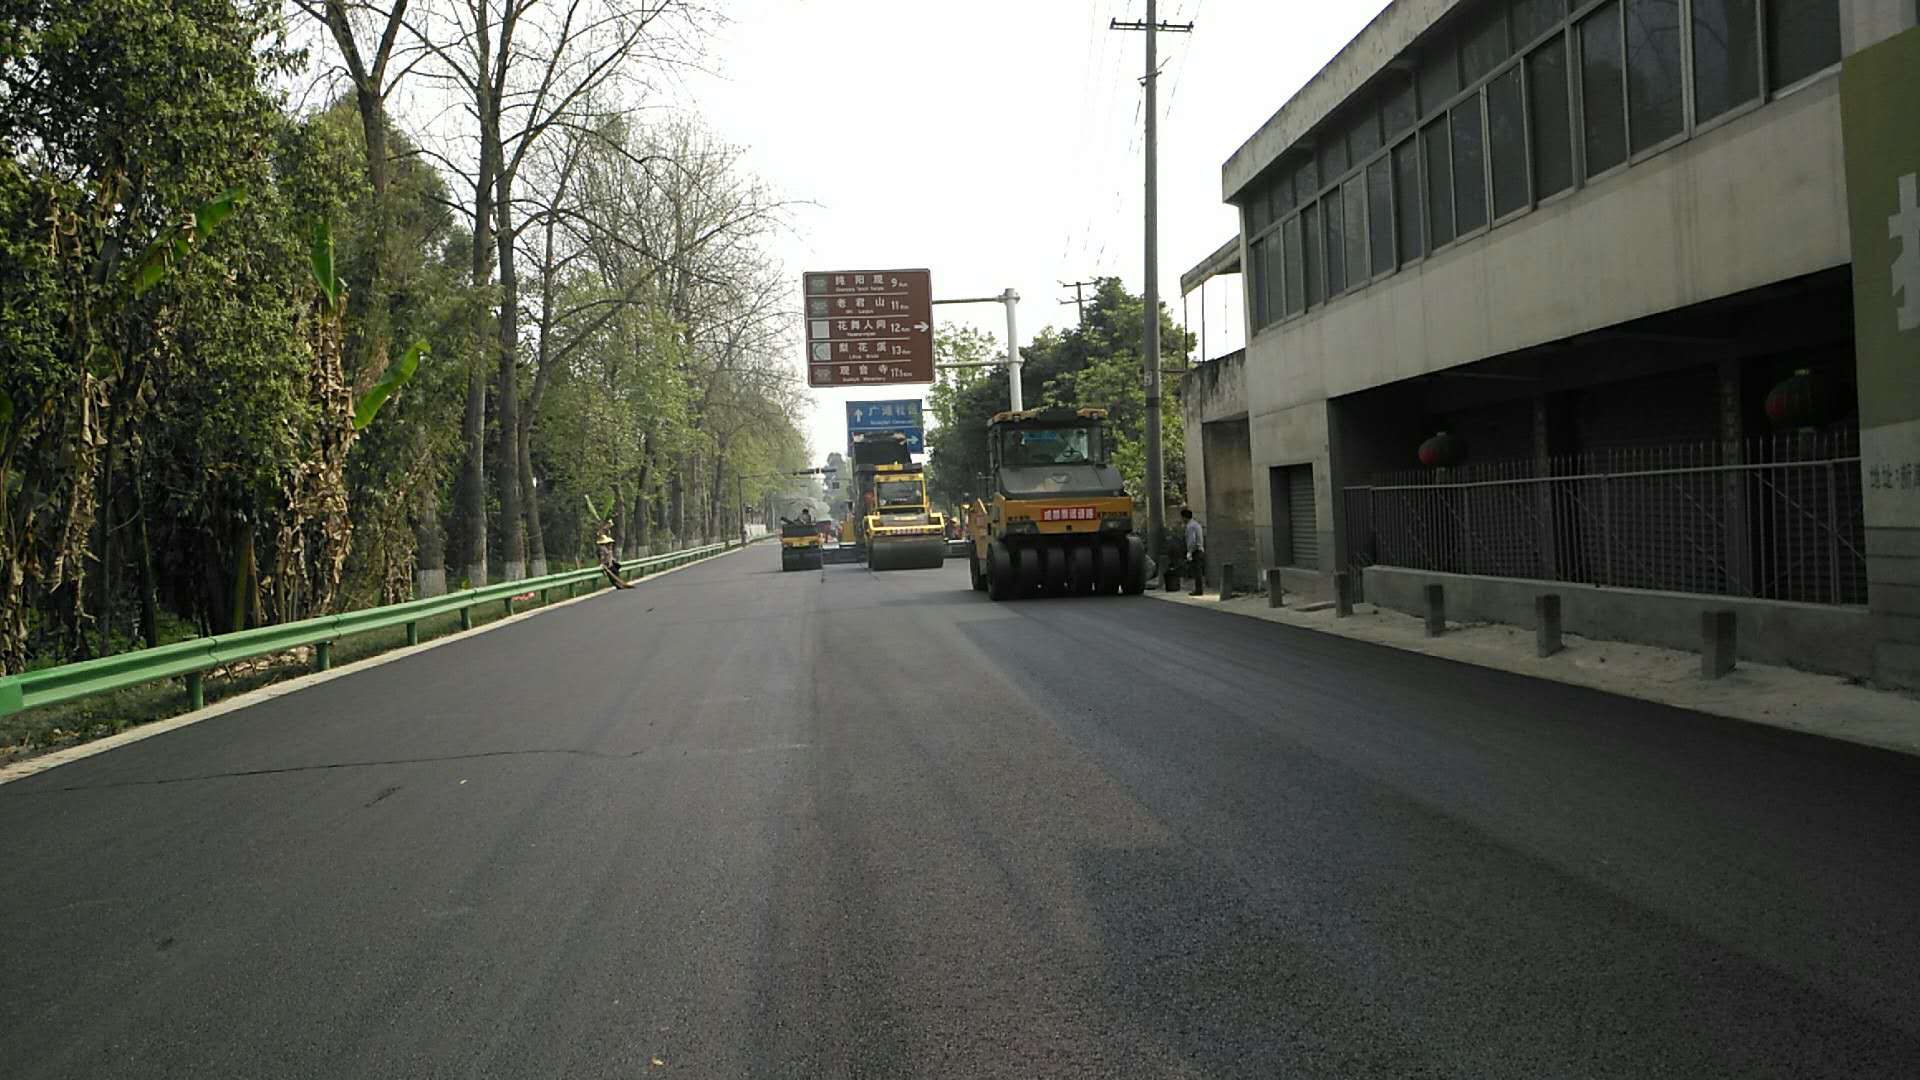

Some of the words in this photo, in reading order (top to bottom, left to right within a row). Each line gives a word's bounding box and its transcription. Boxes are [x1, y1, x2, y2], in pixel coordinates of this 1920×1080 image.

[837, 297, 885, 308] 老君山
[838, 341, 887, 352] 梨花溪
[839, 364, 888, 376] 观音寺
